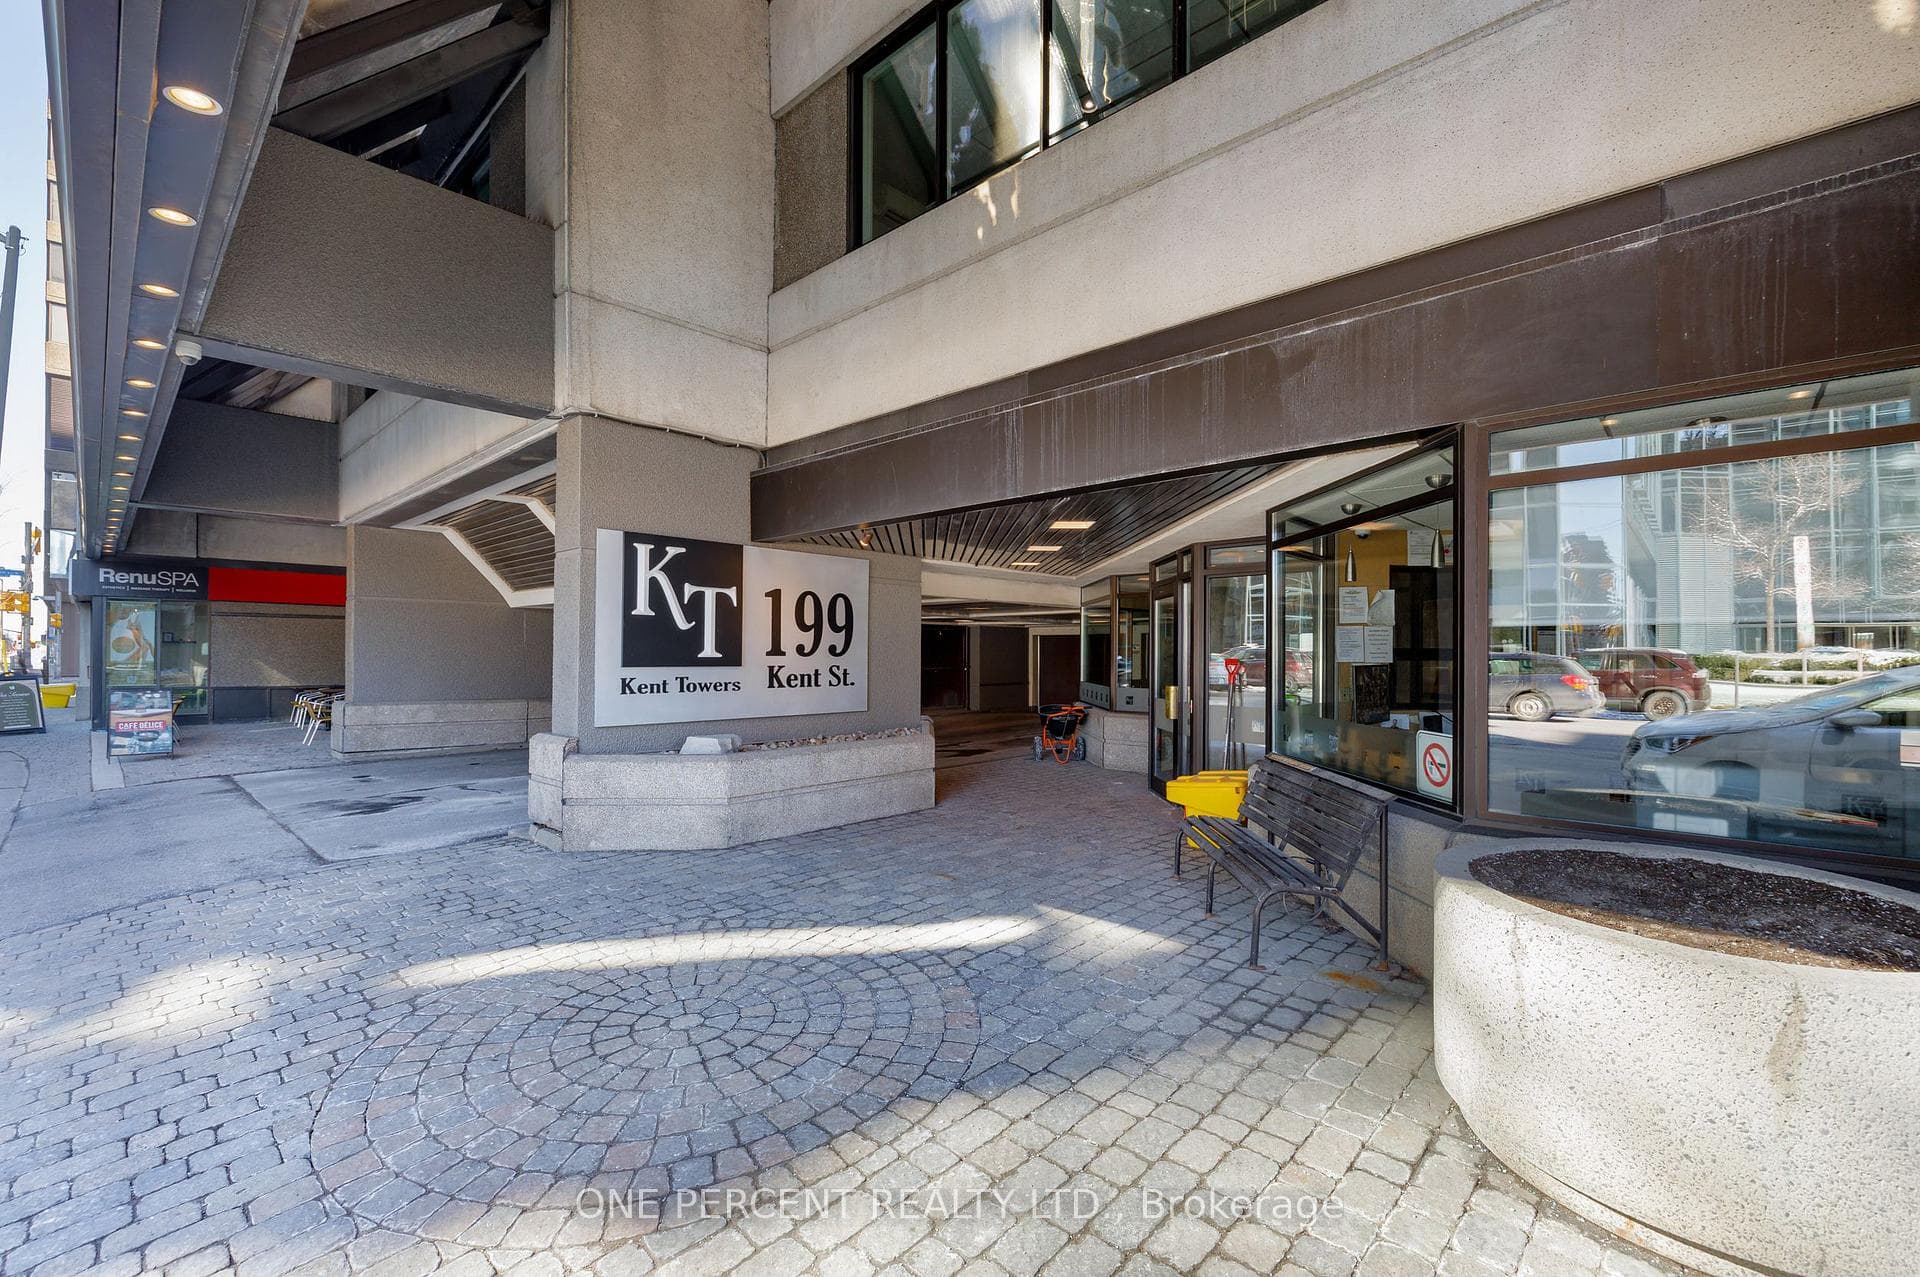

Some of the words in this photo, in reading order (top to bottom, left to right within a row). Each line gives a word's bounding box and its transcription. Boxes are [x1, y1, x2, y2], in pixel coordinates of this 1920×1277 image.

[99, 568, 200, 587] RenuSPA
[630, 542, 738, 658] KT
[764, 588, 854, 658] 199
[620, 677, 669, 695] Kent
[675, 676, 742, 693] Towers
[767, 665, 822, 689] Kent
[828, 664, 856, 688] St.
